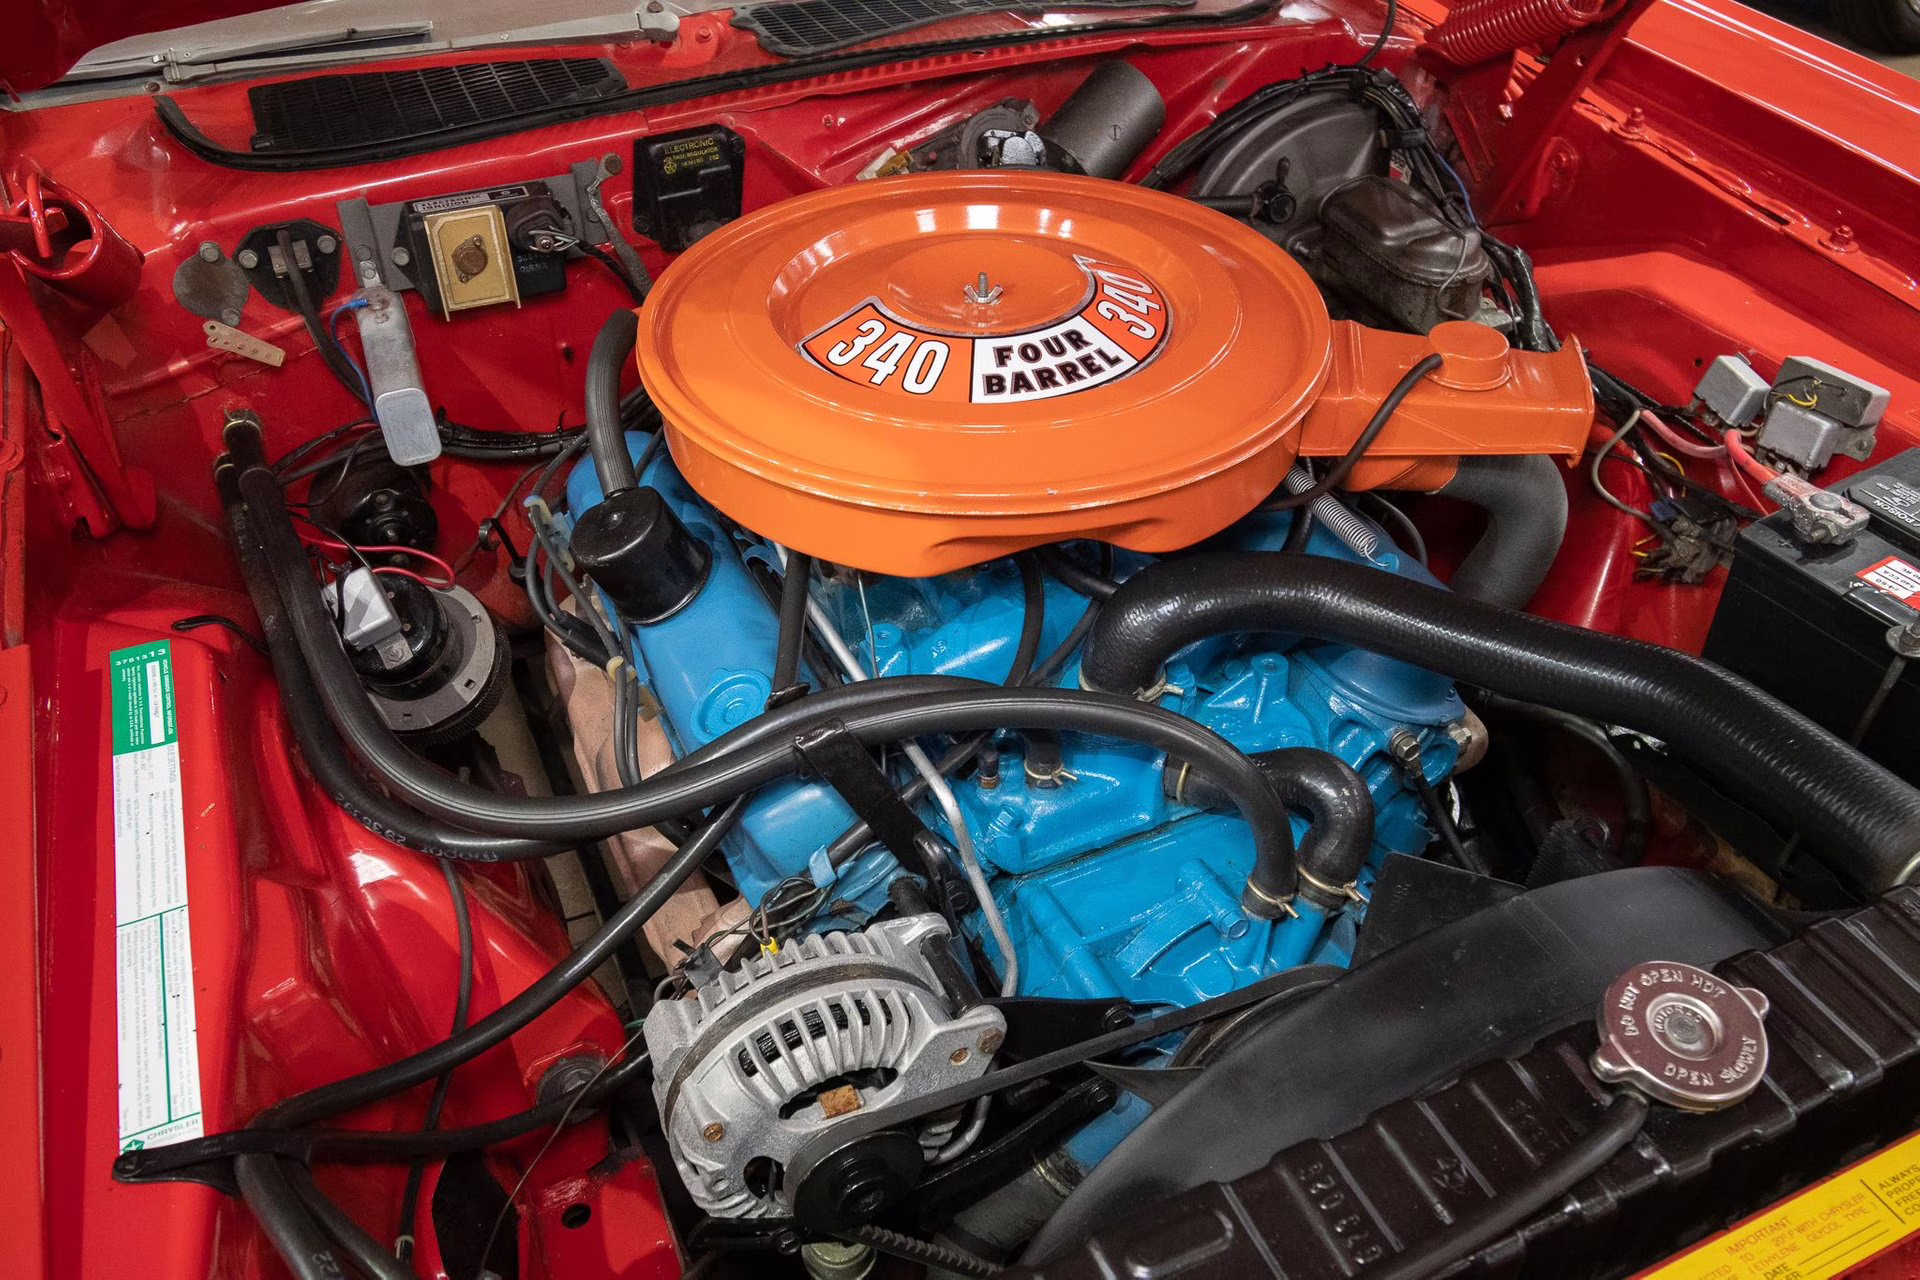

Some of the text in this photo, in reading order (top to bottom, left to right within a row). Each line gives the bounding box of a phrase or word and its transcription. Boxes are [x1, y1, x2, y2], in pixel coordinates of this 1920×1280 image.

[664, 137, 714, 154] ELECTRONIC
[422, 200, 470, 210] IGNITION
[1097, 268, 1161, 340] 340
[827, 319, 951, 395] 340
[992, 328, 1092, 367] FOUR
[982, 347, 1124, 396] BARREL
[1873, 500, 1915, 523] POISON
[1621, 1014, 1640, 1036] DO
[1640, 968, 1684, 987] OPEN
[1691, 974, 1727, 998] HOT
[1664, 1035, 1757, 1087] OPEN SLOWLY
[1878, 1164, 1920, 1190] ALWAYS
[1726, 1216, 1792, 1256] IMPORTANT
[1763, 1263, 1792, 1280] DATE
